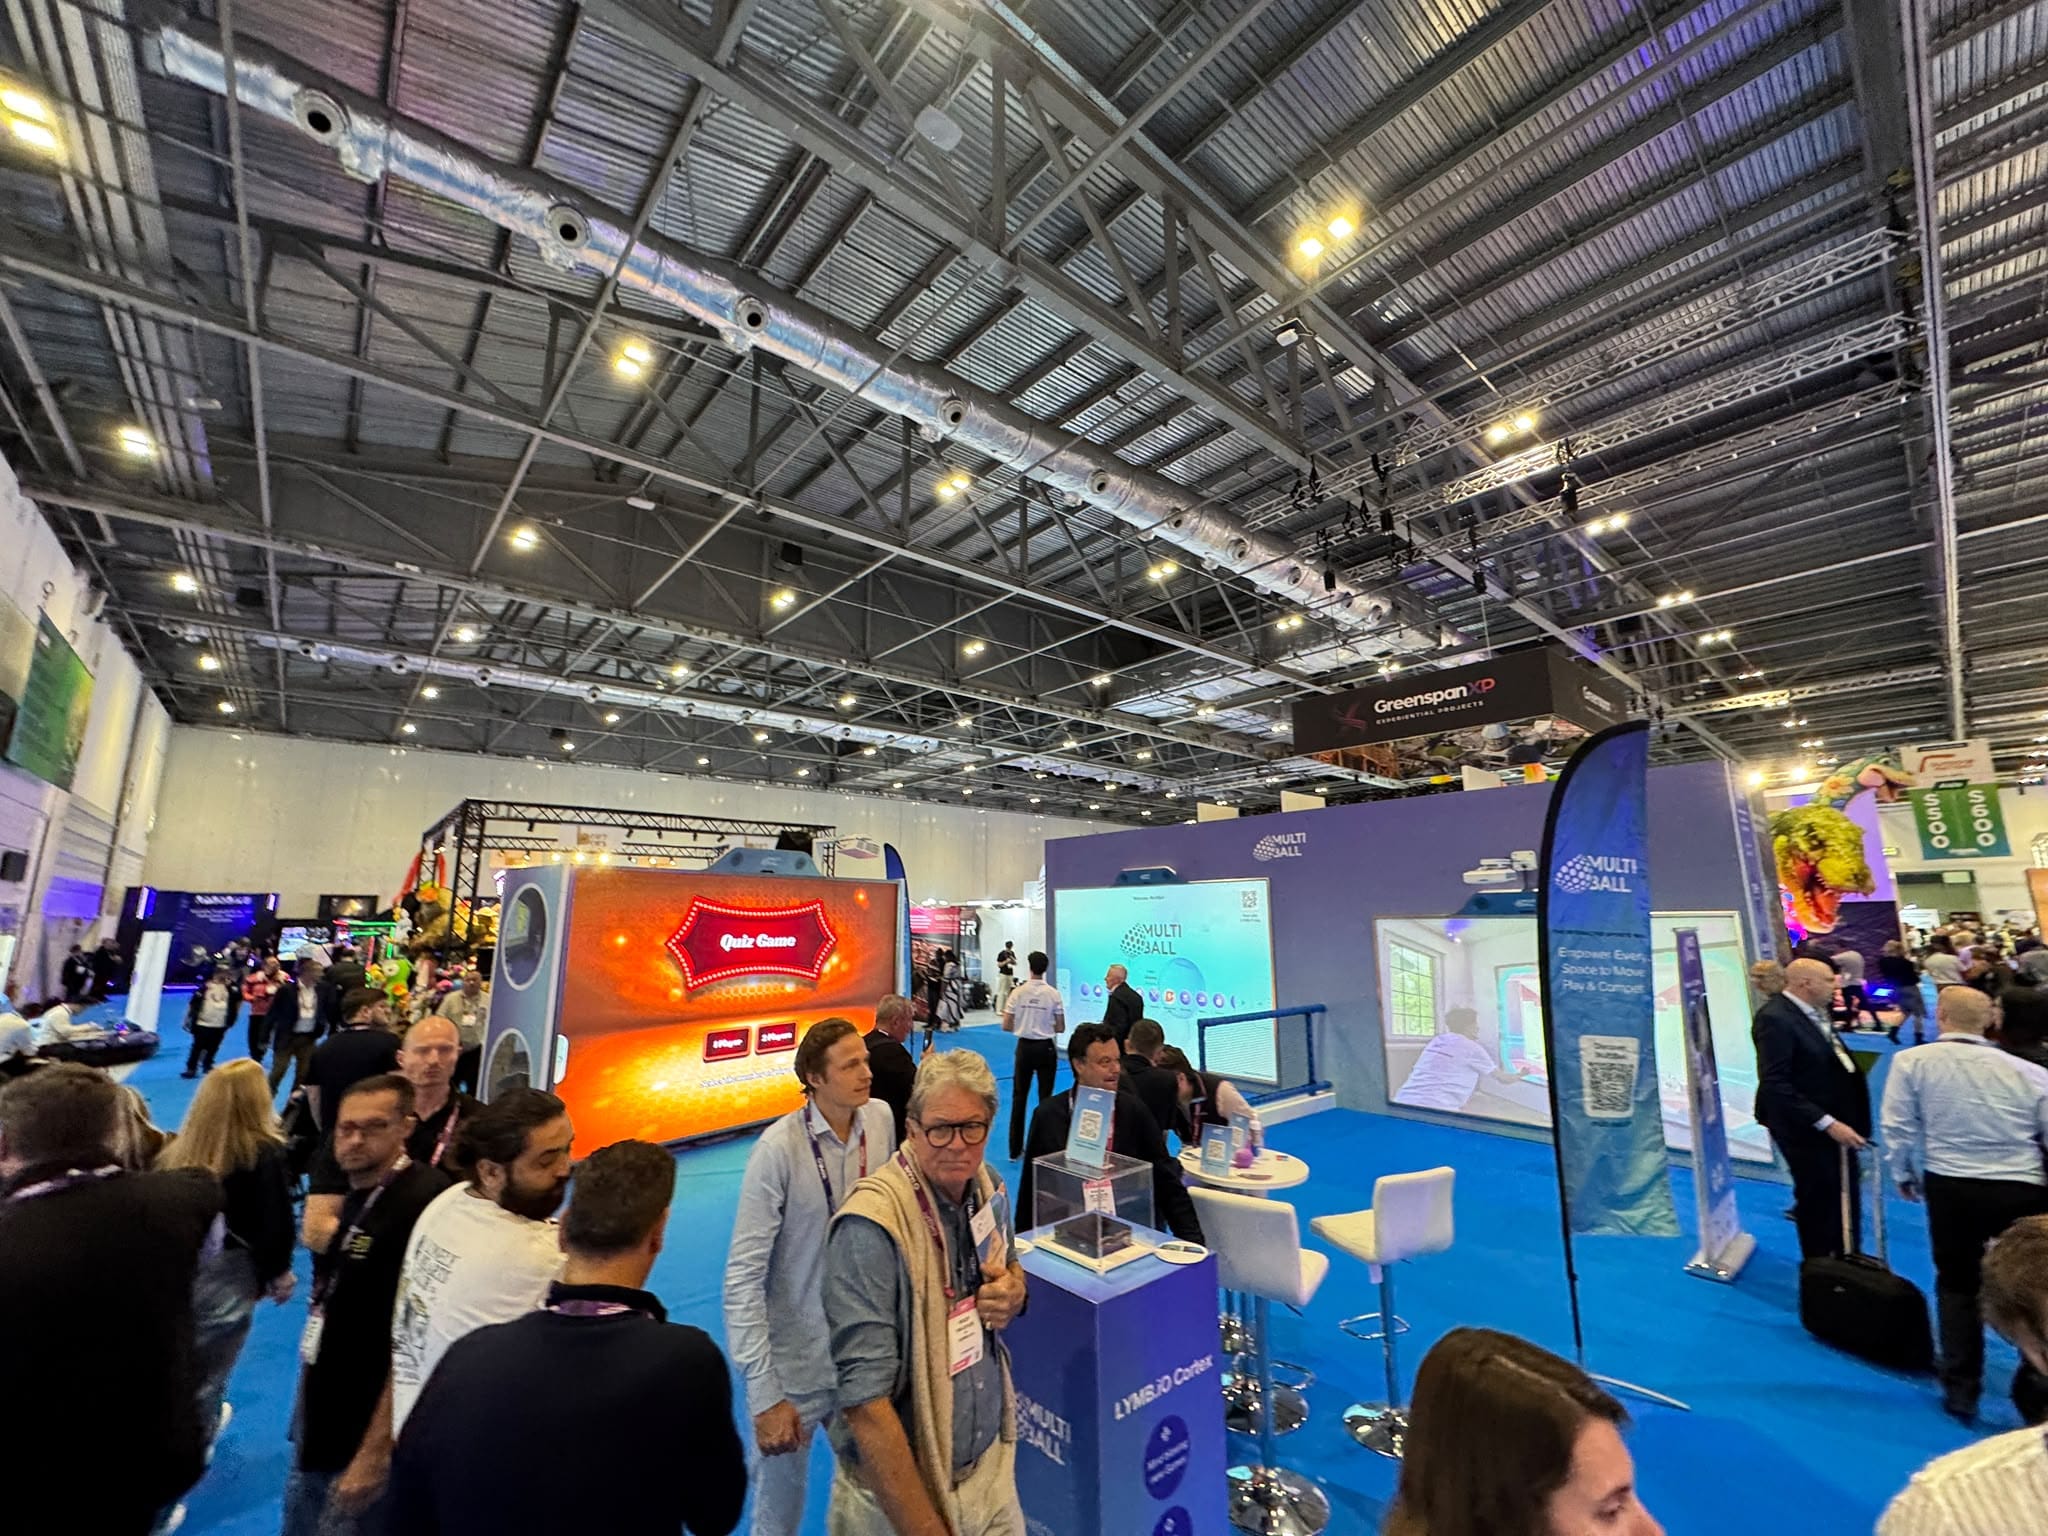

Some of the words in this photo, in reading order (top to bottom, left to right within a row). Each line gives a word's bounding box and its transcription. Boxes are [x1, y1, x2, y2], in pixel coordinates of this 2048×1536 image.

[1375, 709, 1436, 726] EXPERIENTIAL
[1437, 699, 1485, 714] PROJECTS
[1272, 831, 1307, 846] MULTI
[1587, 854, 1638, 875] MULTI
[1142, 923, 1182, 939] MULTI
[720, 933, 755, 953] Quiz
[756, 933, 797, 948] Game
[1561, 963, 1598, 976] Space
[1563, 978, 1585, 993] Play
[1586, 981, 1597, 992] &
[1173, 1354, 1213, 1386] Cortex
[1030, 1402, 1072, 1444] MULTI
